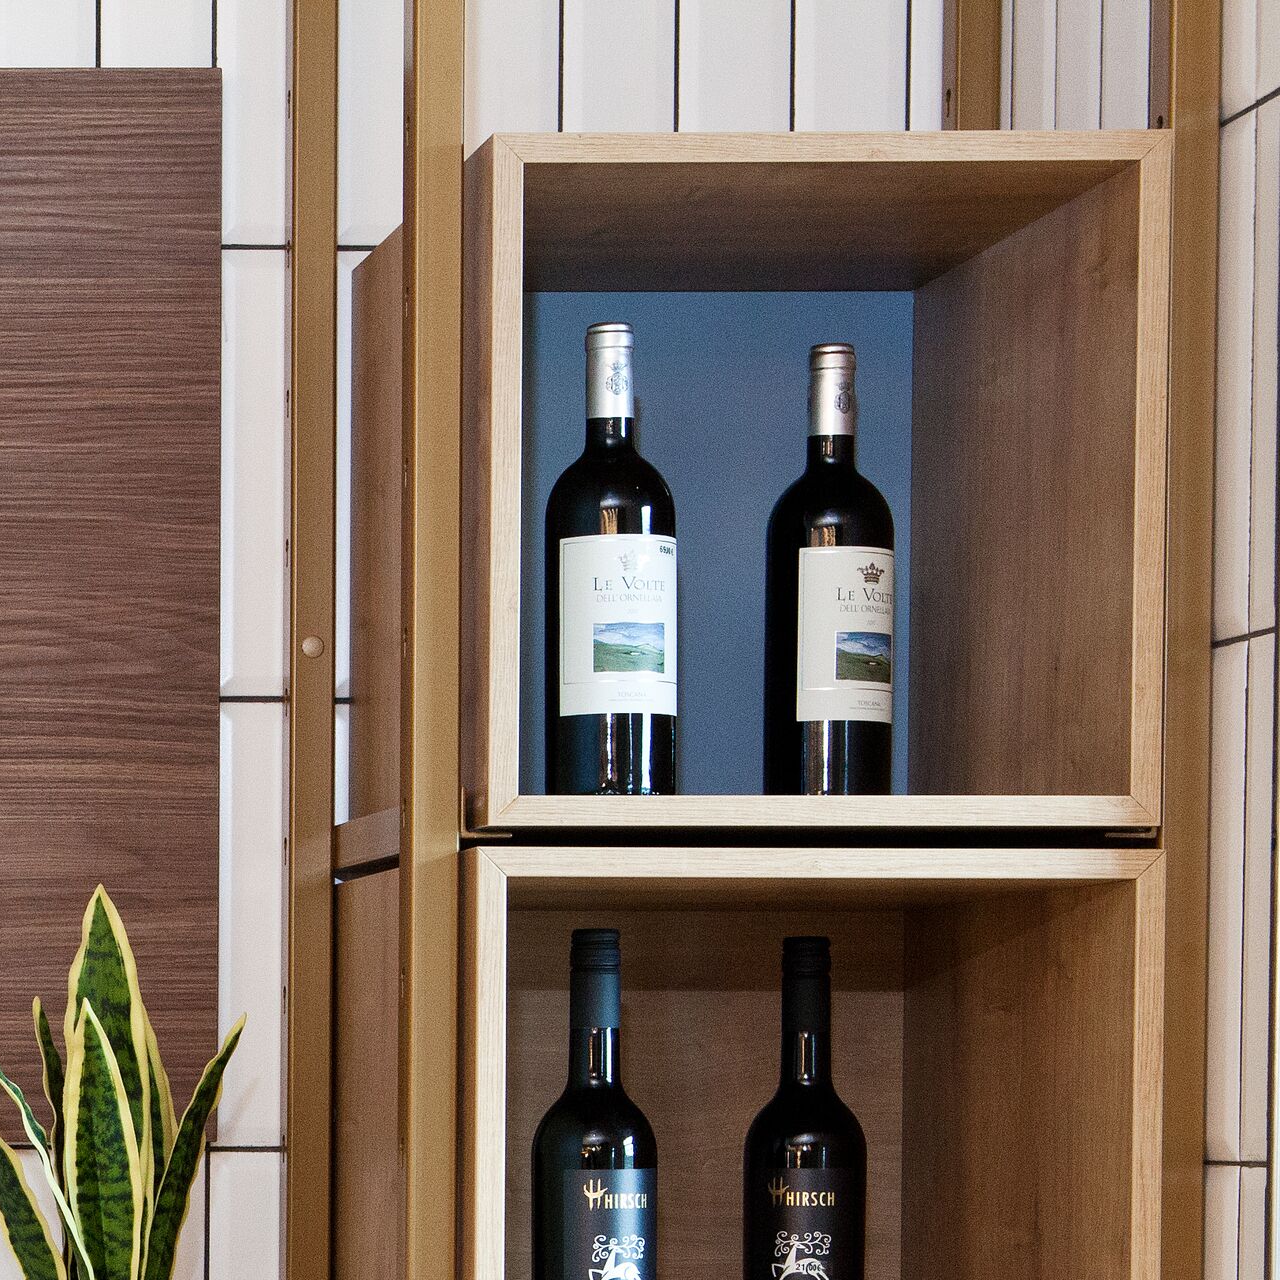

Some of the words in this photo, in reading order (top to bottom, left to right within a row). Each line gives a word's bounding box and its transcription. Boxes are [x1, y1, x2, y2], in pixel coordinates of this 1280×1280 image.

[593, 576, 613, 591] LE
[622, 575, 666, 592] VOLTE
[836, 587, 855, 602] LE
[604, 1193, 647, 1210] HIRSCH
[786, 1191, 835, 1207] HIRSCH
